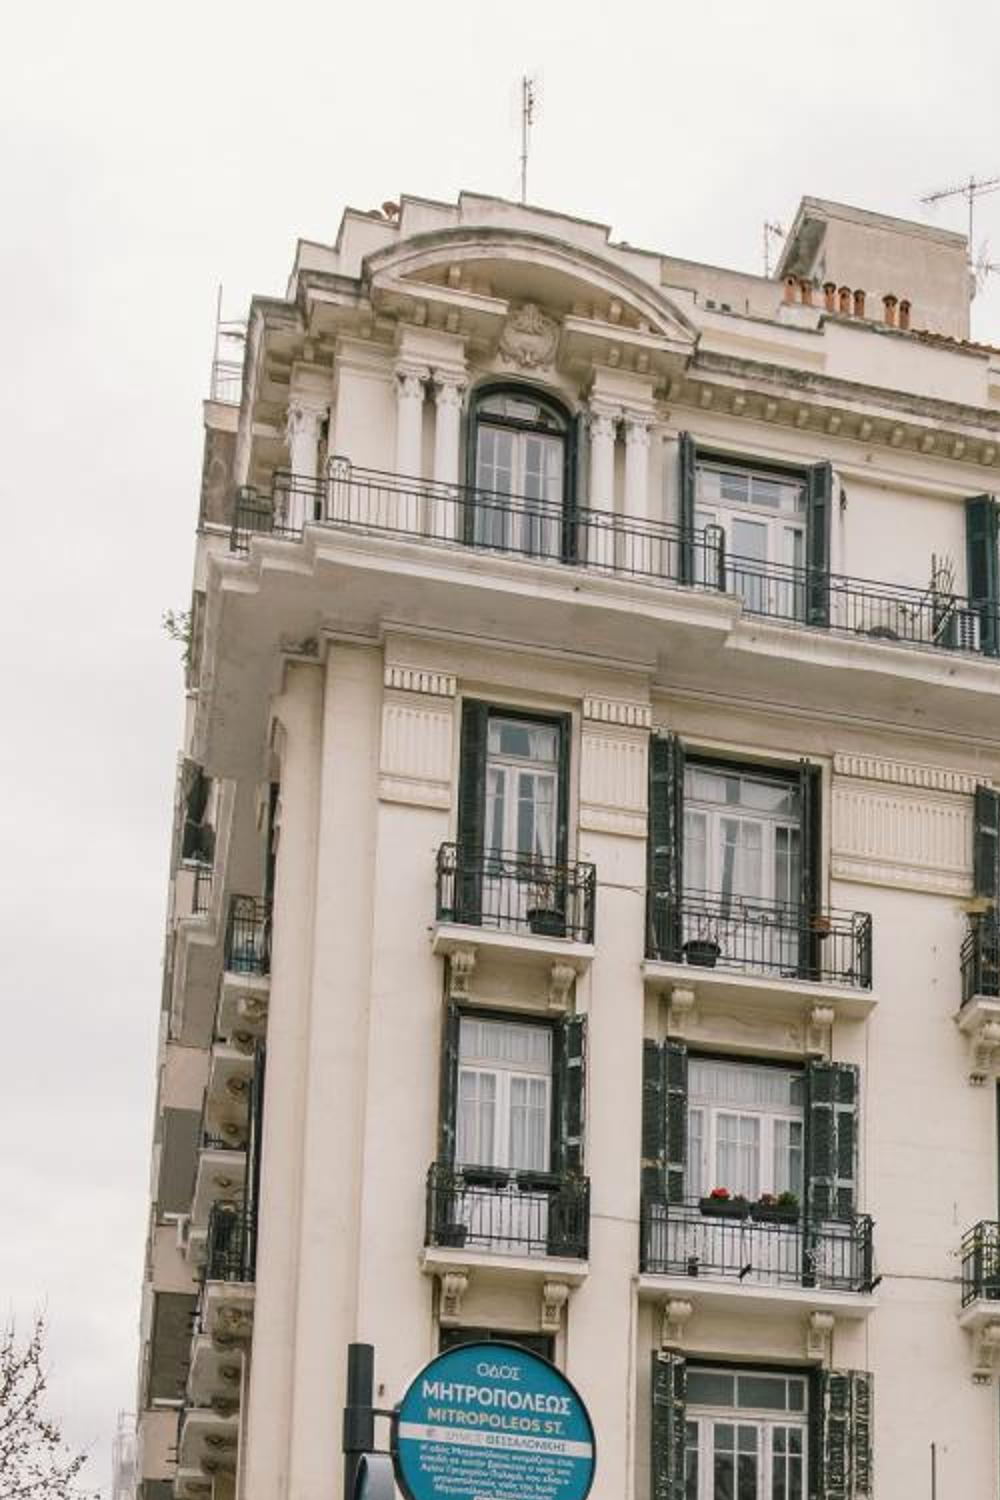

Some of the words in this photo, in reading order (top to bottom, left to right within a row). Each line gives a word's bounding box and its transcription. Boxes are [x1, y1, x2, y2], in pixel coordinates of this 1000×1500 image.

[476, 1362, 521, 1381] ΟΔΟΣ
[422, 1380, 571, 1415] ΜΗΤΡΟΠΟΛΕΩΣ
[427, 1407, 540, 1431] MITROPOLEOS
[543, 1418, 565, 1434] ST.
